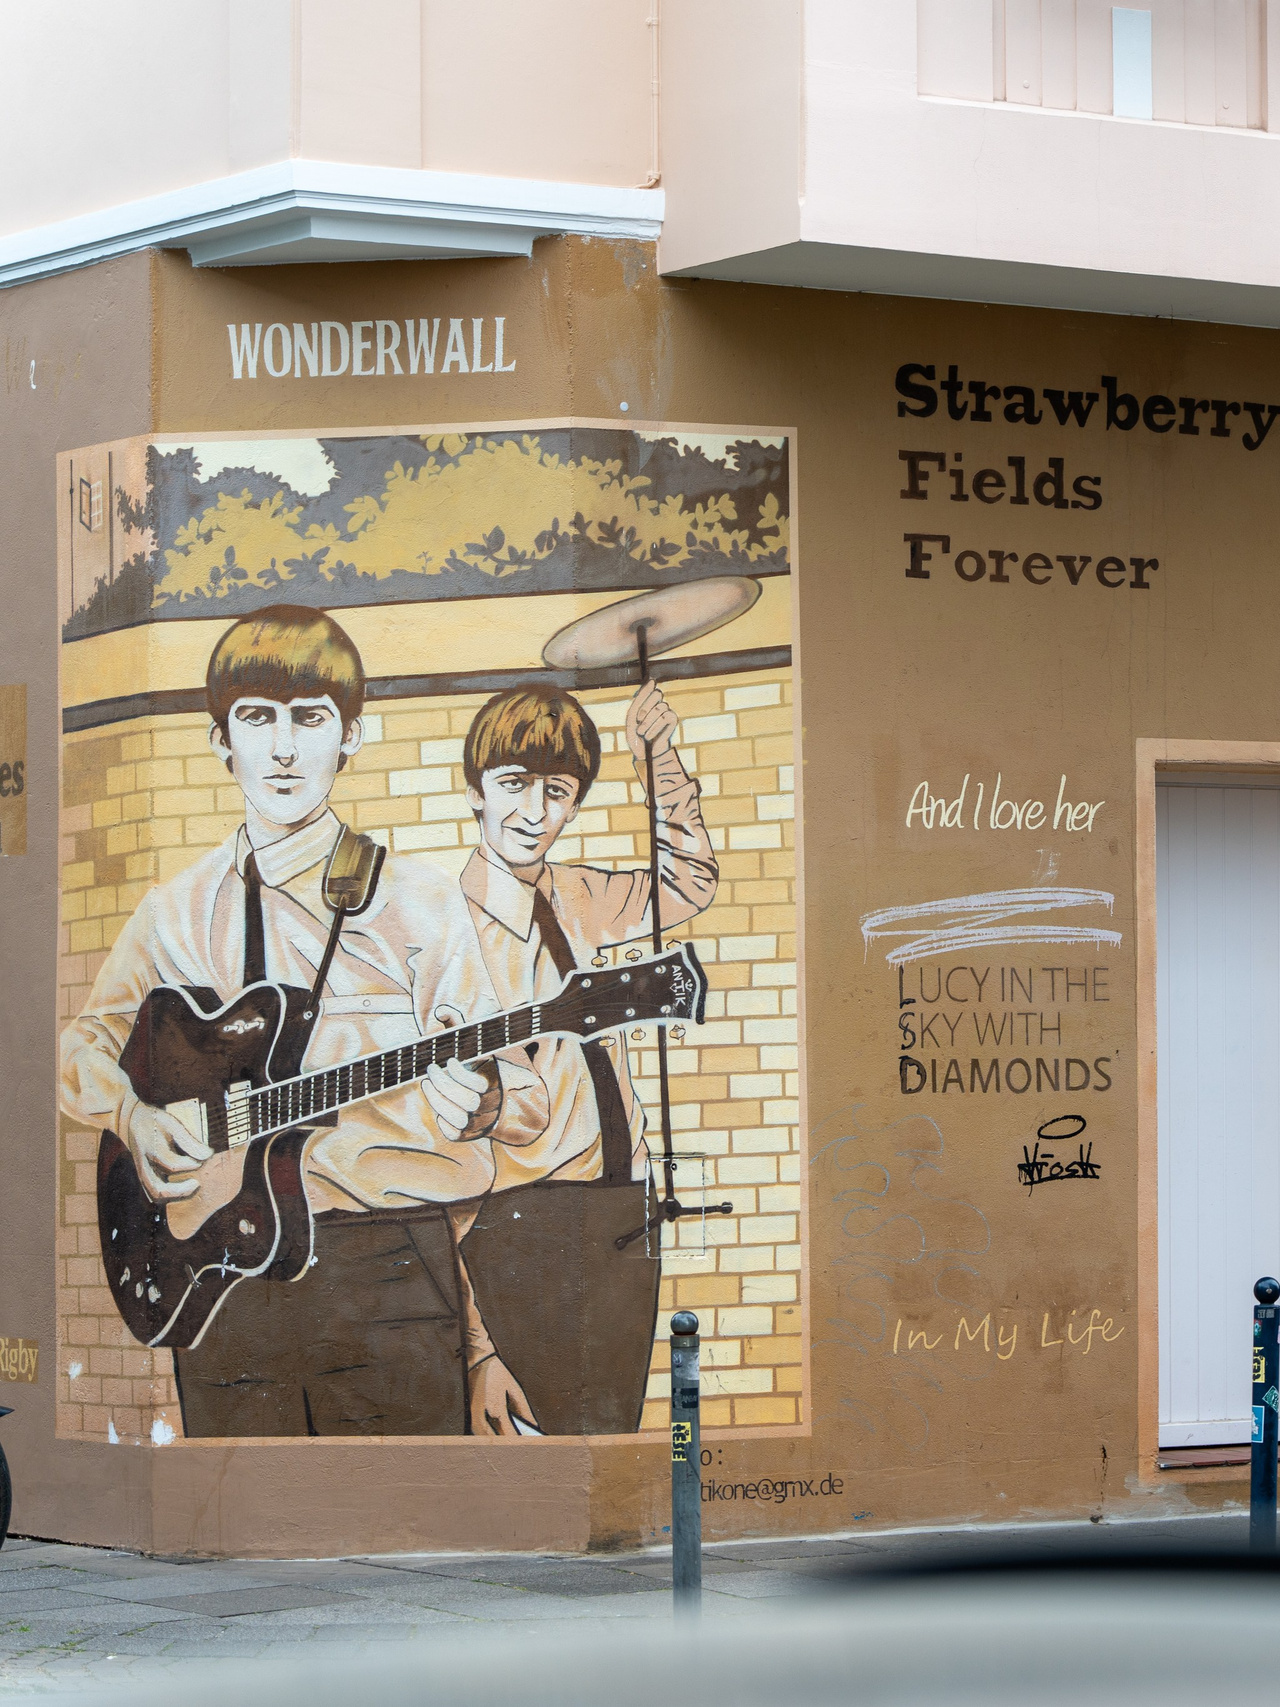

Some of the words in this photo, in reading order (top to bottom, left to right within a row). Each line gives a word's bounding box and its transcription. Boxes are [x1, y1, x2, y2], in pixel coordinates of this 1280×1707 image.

[226, 317, 517, 379] WONDERWALL
[898, 449, 1103, 511] Fields
[903, 533, 1160, 590] Forever
[905, 773, 971, 829] And
[973, 782, 984, 830] I
[990, 771, 1047, 830] love
[1052, 773, 1106, 832] her
[898, 965, 991, 1009] LUCY
[1001, 966, 1033, 1003] IN
[1042, 966, 1110, 1003] THE
[898, 1011, 963, 1050] SKY
[973, 1011, 1061, 1047] WITH
[898, 1055, 1113, 1095] DIAMONDS
[893, 1319, 943, 1354] In
[954, 1312, 1018, 1360] My
[1041, 1309, 1125, 1355] Life
